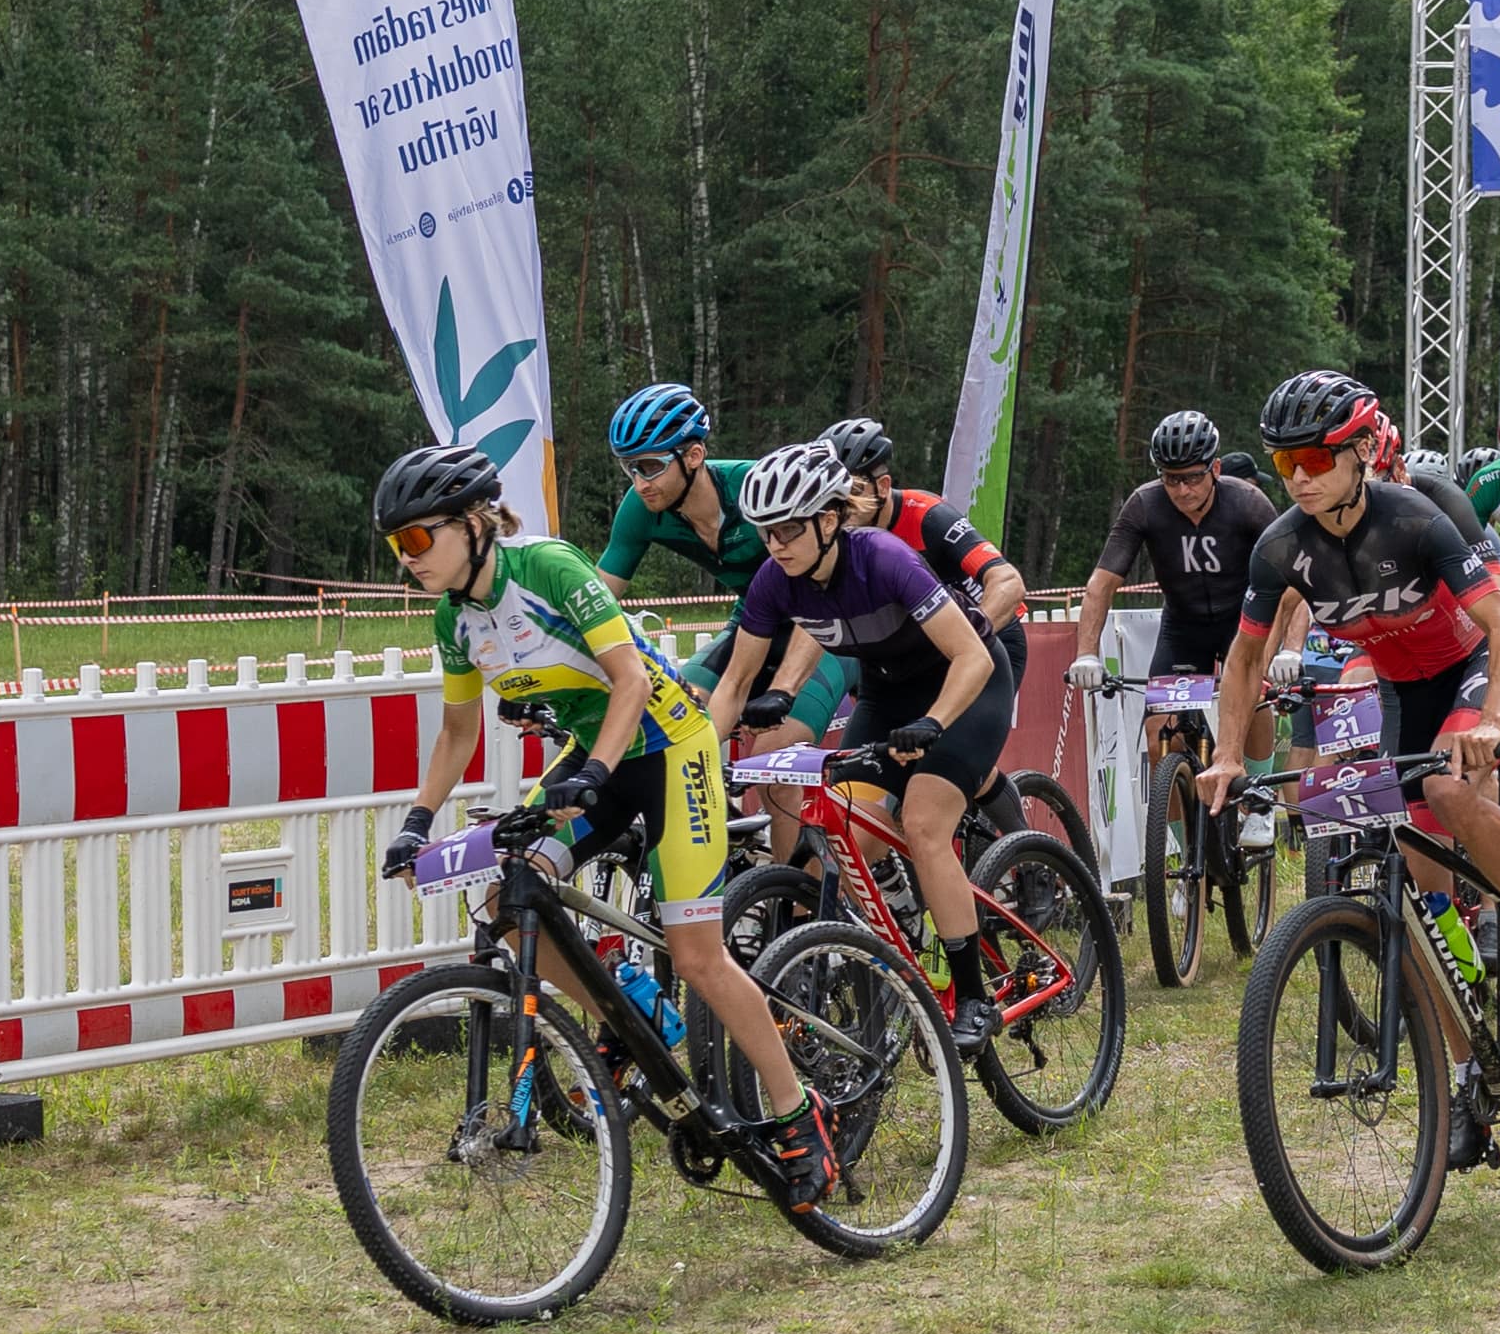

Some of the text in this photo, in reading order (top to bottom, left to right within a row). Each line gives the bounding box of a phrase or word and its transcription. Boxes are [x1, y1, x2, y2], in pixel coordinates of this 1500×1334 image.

[1180, 536, 1221, 574] KS
[1167, 689, 1190, 702] 16
[1332, 716, 1360, 740] 21
[766, 752, 798, 770] 12
[440, 842, 468, 874] 17
